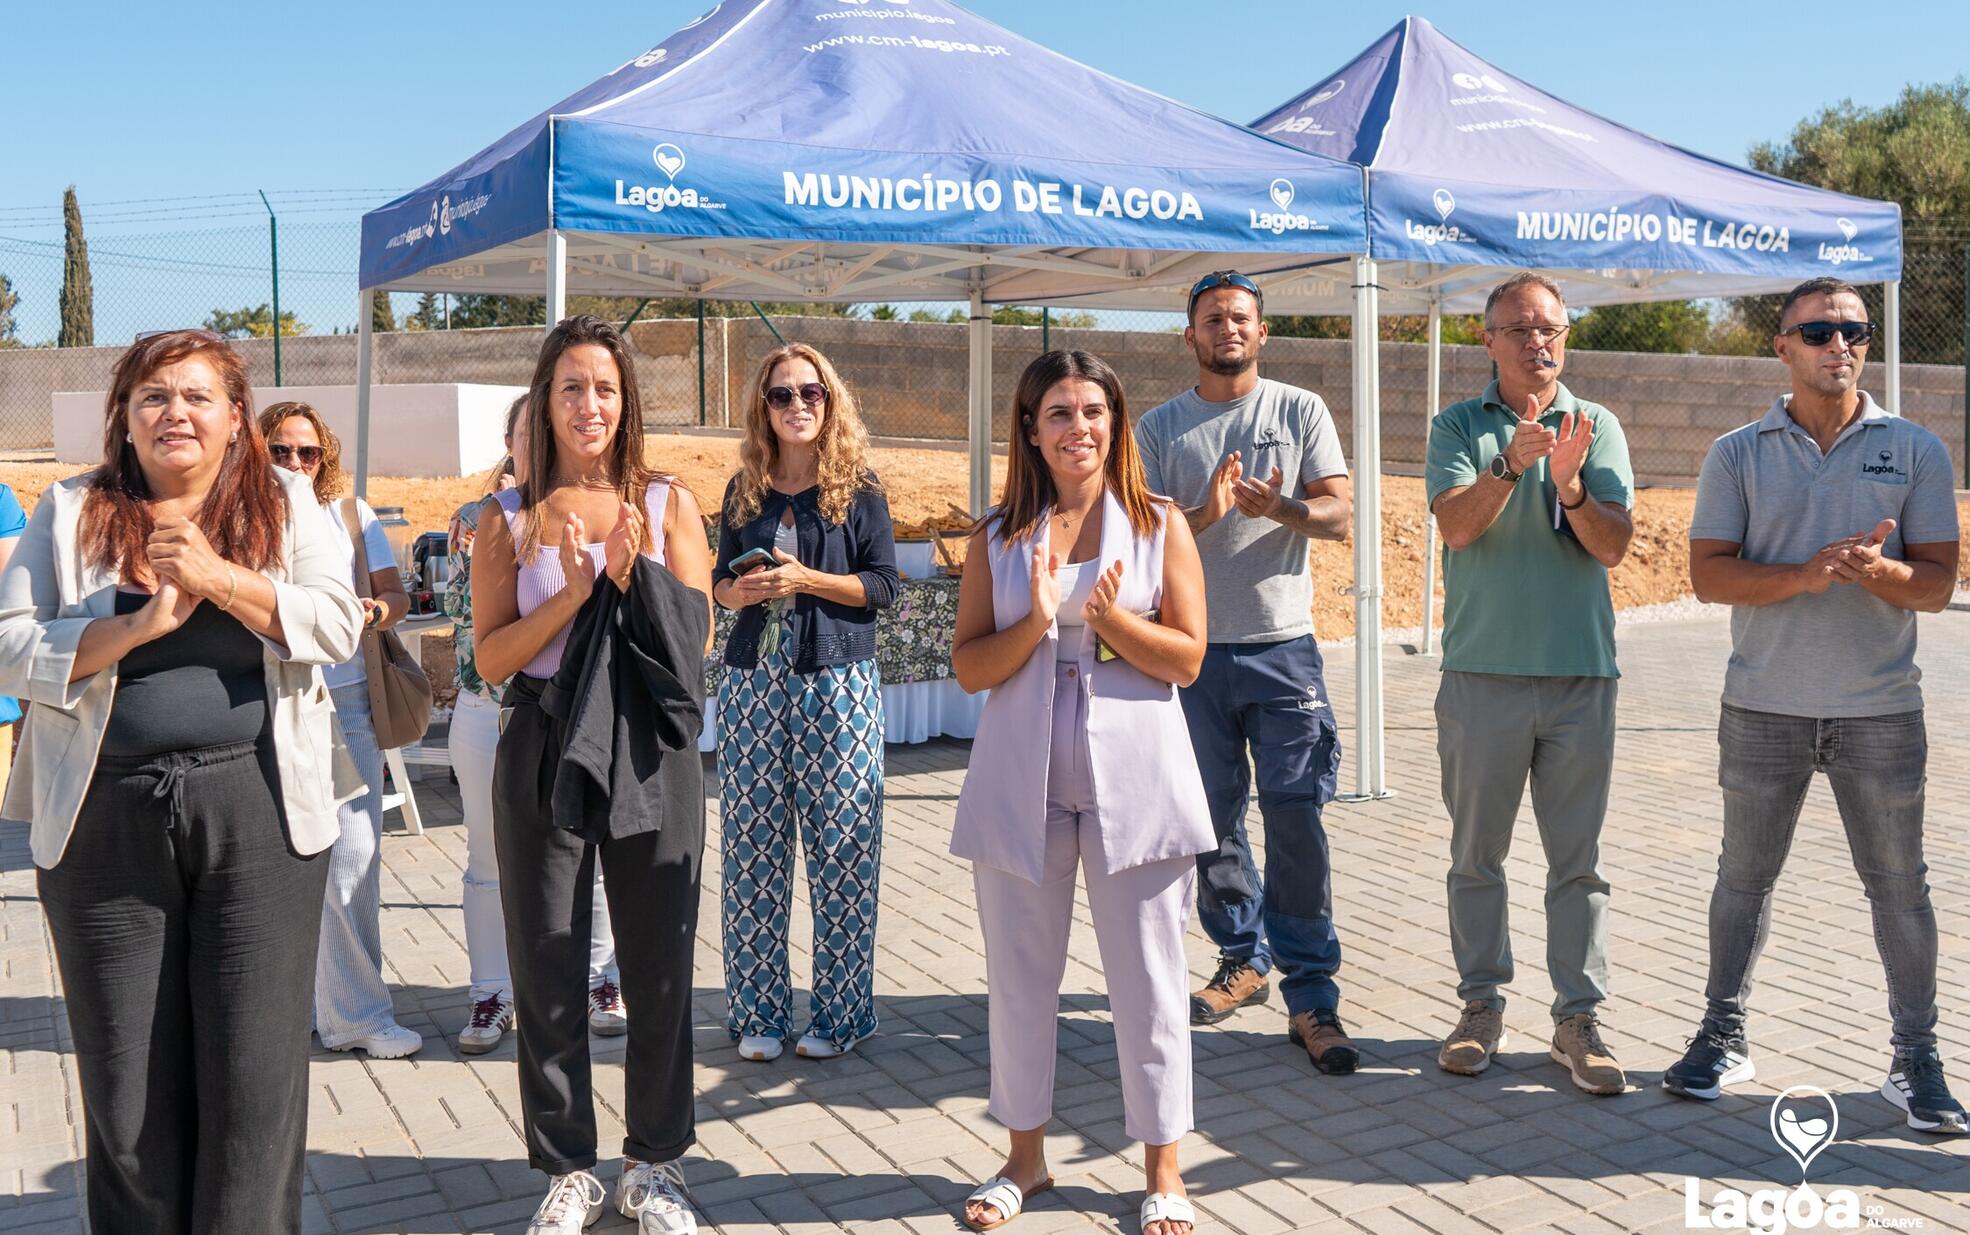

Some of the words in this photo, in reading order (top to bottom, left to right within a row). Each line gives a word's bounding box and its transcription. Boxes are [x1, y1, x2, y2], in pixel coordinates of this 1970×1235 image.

[803, 34, 1012, 56] www.cm-lagoa.pt
[615, 180, 699, 213] Lagoa
[783, 172, 1002, 213] MUNICÍPIO
[1013, 179, 1063, 215] DE
[1073, 184, 1204, 221] LAGOA
[1249, 208, 1310, 235] Lagoa
[1405, 219, 1460, 246] Lagoa
[1516, 206, 1662, 242] MUNICÍPIO
[1667, 214, 1698, 246] DE
[1702, 219, 1790, 253] LAGOA
[1818, 241, 1859, 265] Lagoa
[1254, 440, 1280, 450] Lagoa
[1863, 463, 1894, 475] Lagoa
